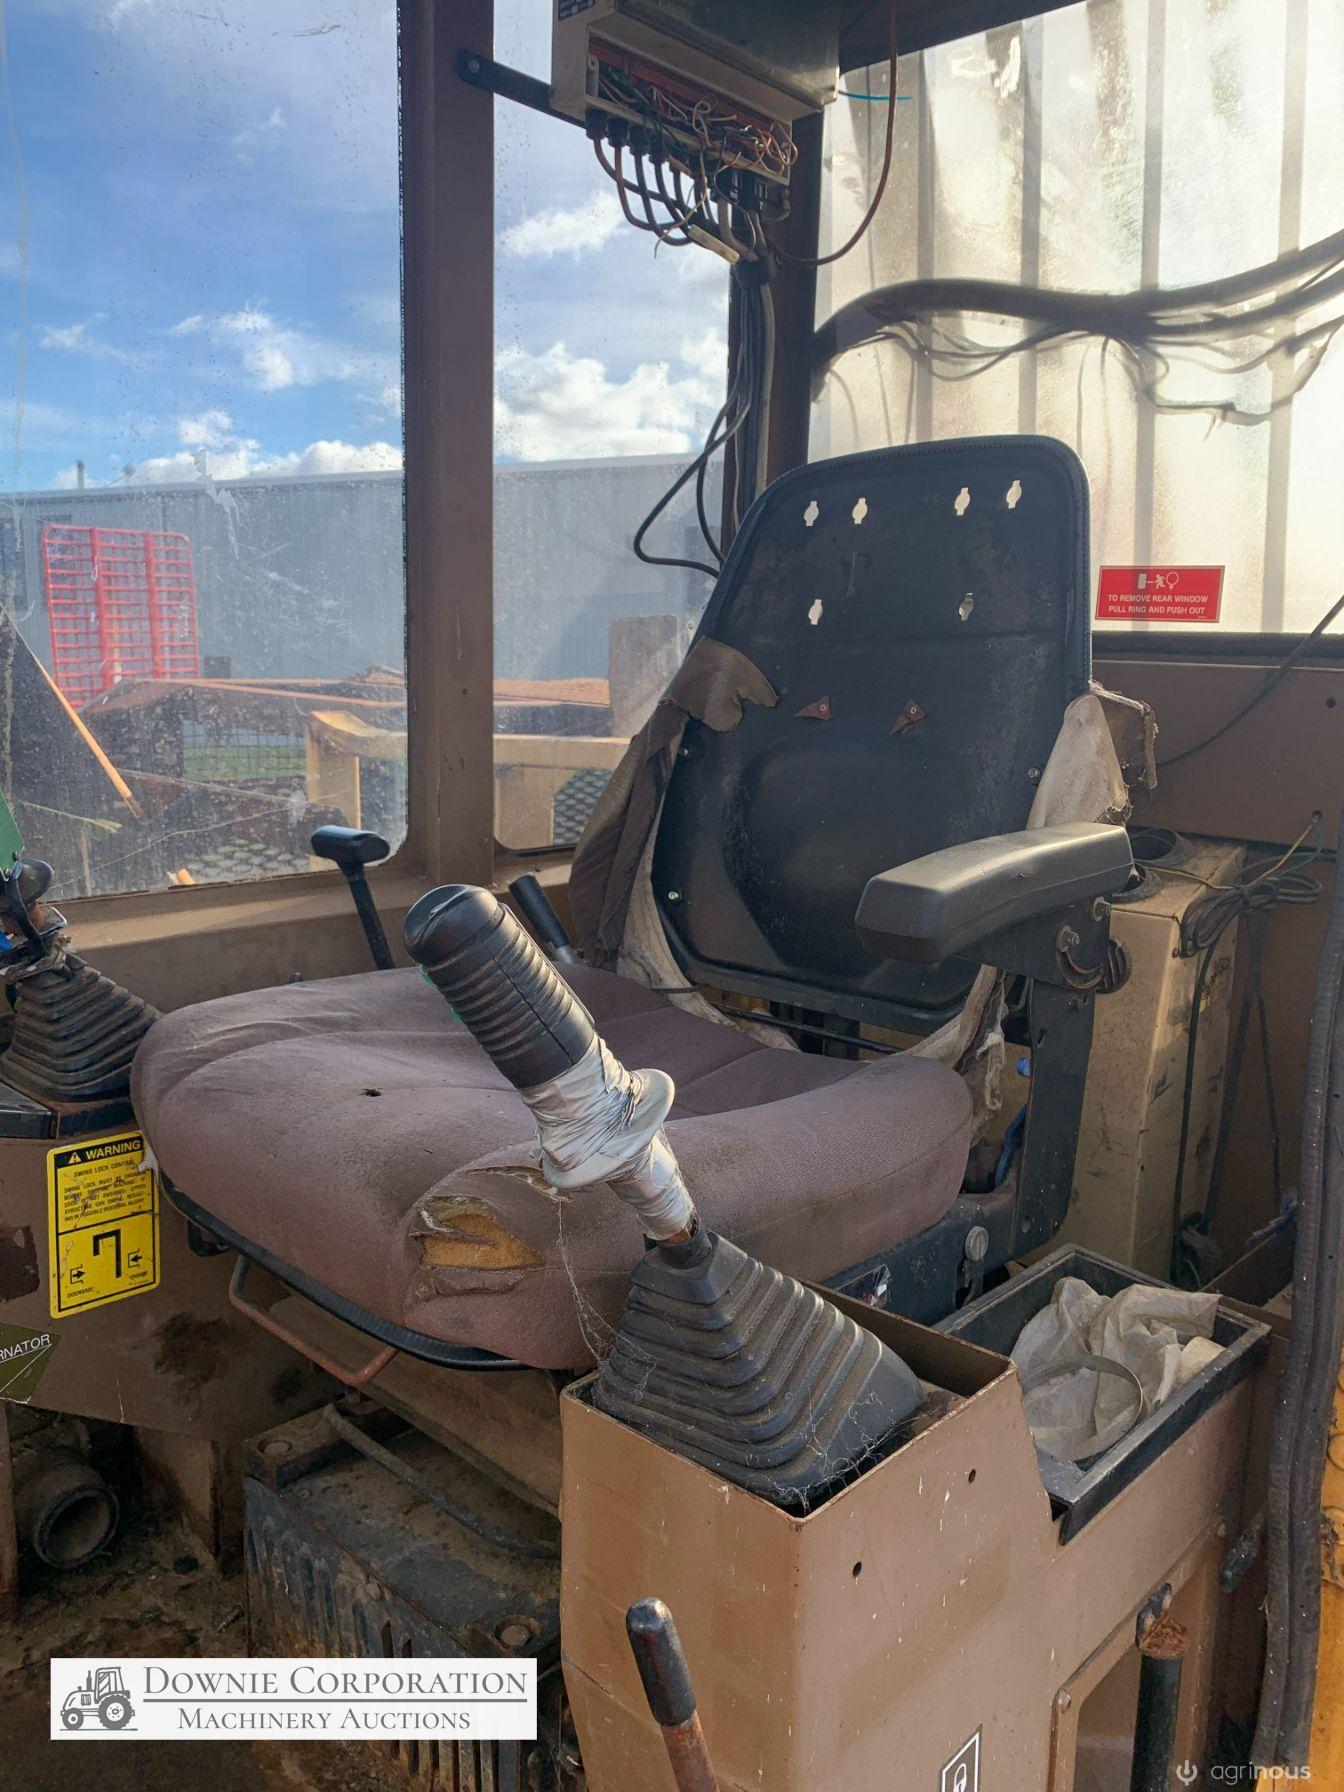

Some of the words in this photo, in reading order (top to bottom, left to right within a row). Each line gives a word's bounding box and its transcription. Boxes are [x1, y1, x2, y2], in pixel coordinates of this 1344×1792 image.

[1108, 594, 1118, 602] TO
[1119, 594, 1151, 603] REMOVE
[1152, 595, 1173, 603] REAR
[1174, 595, 1209, 603] WINDOW
[1108, 605, 1127, 613] PULL
[1128, 605, 1147, 613] RING
[1148, 606, 1166, 614] AND
[1166, 606, 1188, 614] PUSH
[1189, 606, 1206, 614] OUT
[86, 1140, 141, 1160] WARNING
[73, 1168, 93, 1177] SWING
[99, 1177, 112, 1185] MUST
